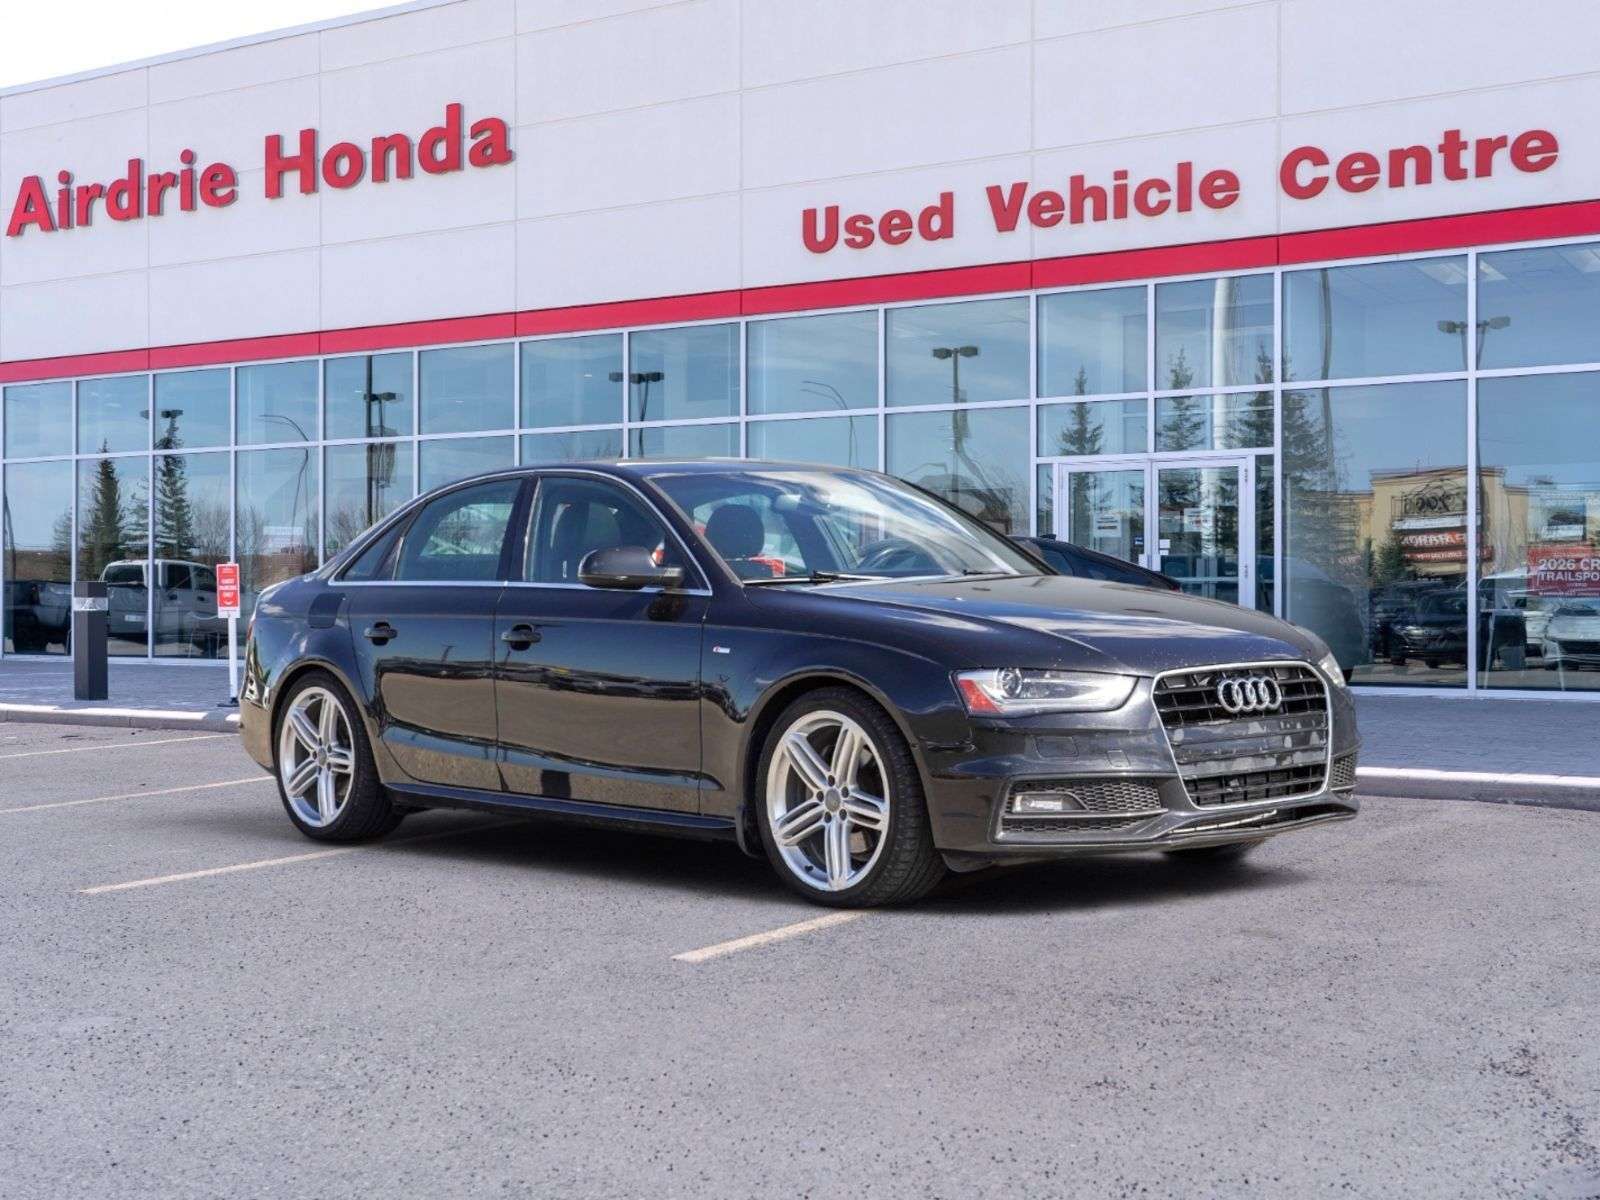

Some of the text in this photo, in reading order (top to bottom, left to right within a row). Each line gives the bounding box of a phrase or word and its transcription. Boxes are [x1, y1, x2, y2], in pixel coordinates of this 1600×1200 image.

[7, 103, 513, 237] Airdrie Honda
[802, 129, 1559, 254] Used Vehicle Centre
[1538, 558, 1576, 571] 2026
